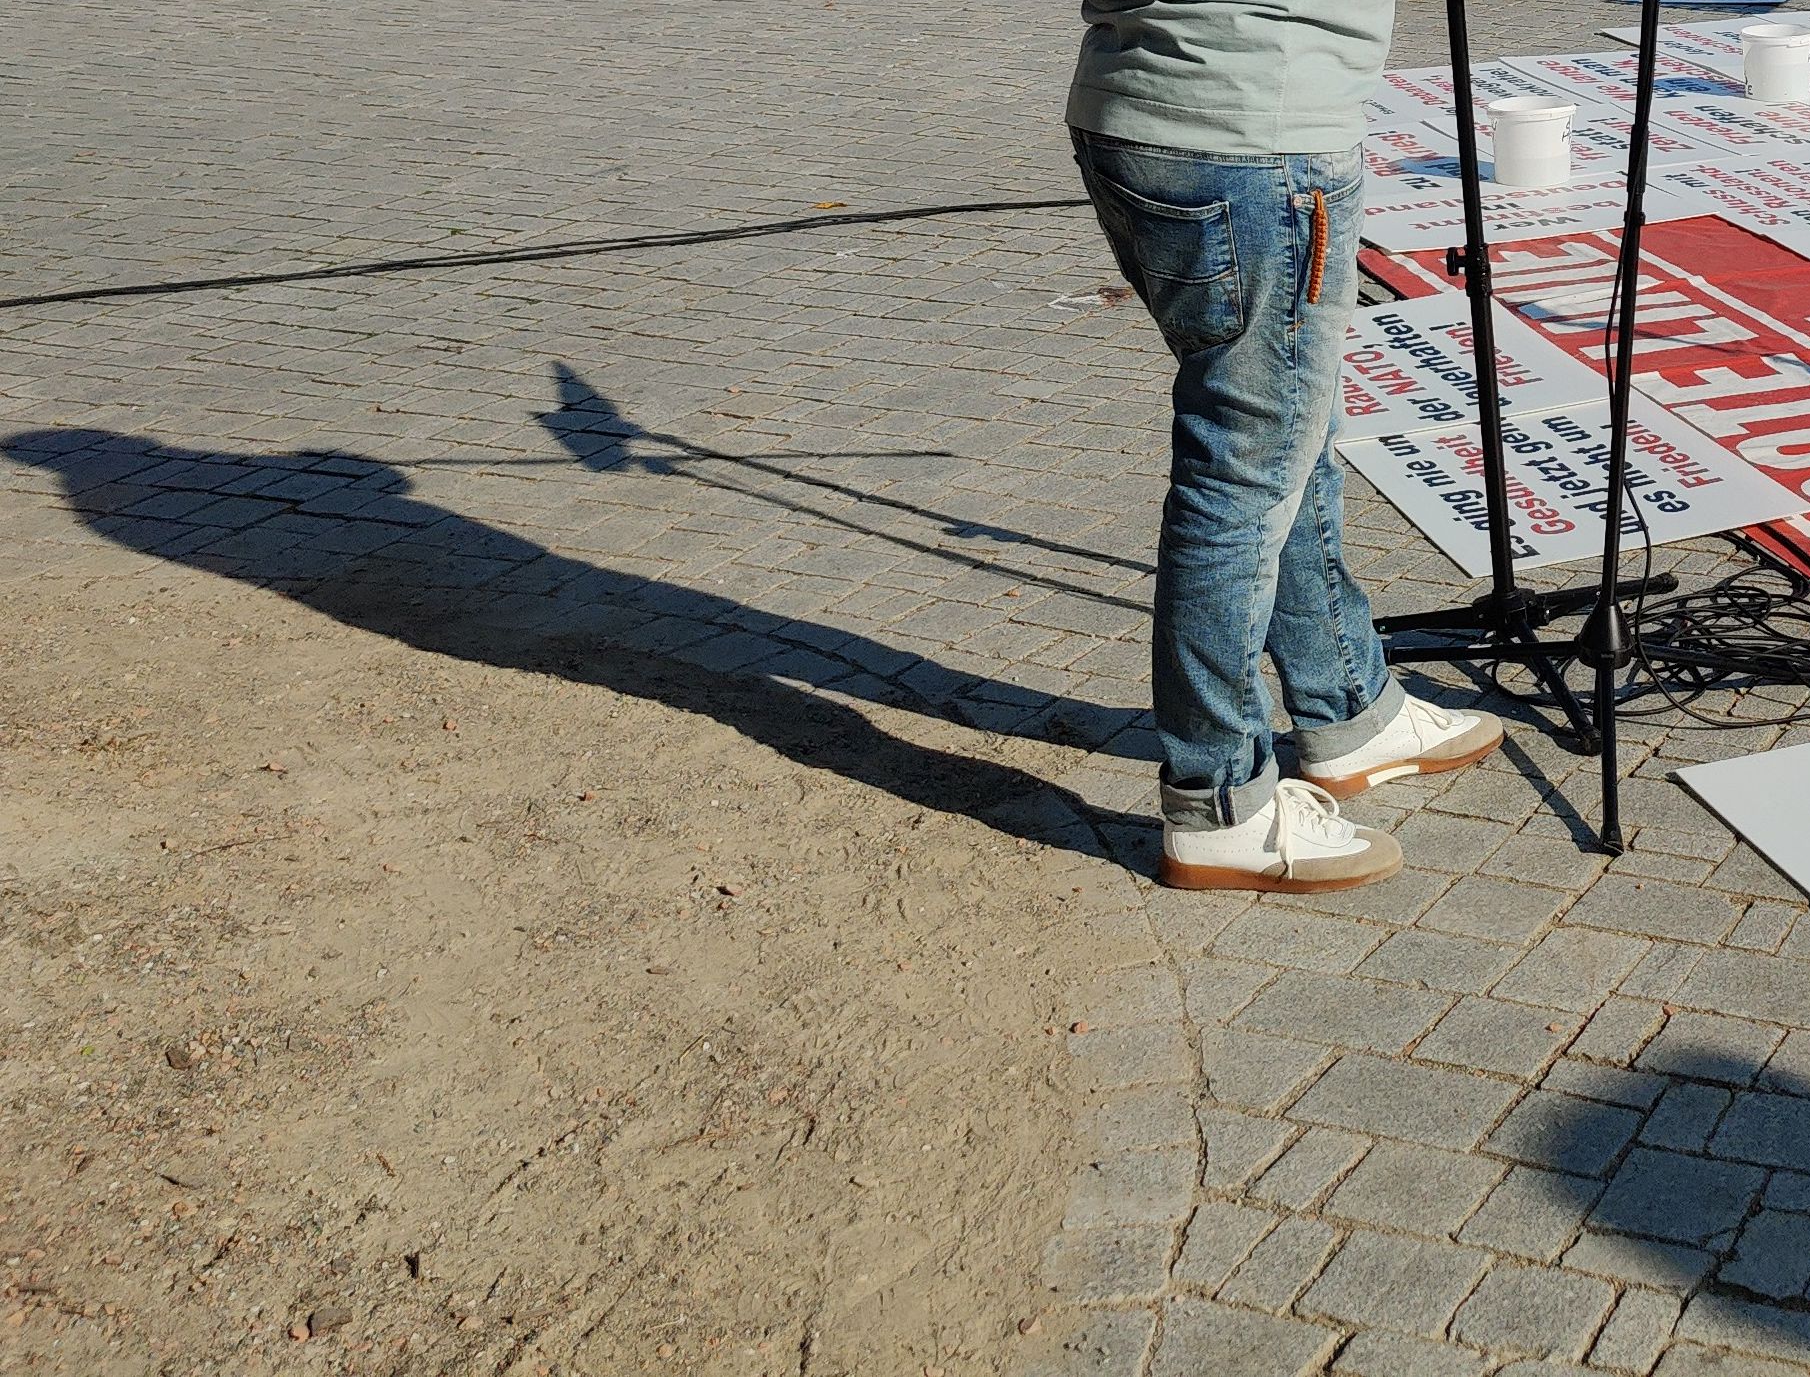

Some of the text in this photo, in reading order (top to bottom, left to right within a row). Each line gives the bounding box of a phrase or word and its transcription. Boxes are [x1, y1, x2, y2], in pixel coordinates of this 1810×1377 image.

[1537, 61, 1647, 101] Wie lange
[1663, 111, 1766, 144] Frieden
[1400, 177, 1442, 189] zu
[1662, 174, 1790, 225] Schluss mit
[1689, 165, 1798, 208] Russland-
[1489, 242, 1759, 360] LINIE
[1343, 344, 1465, 421] der NATO,
[1521, 456, 1607, 499] jetzt
